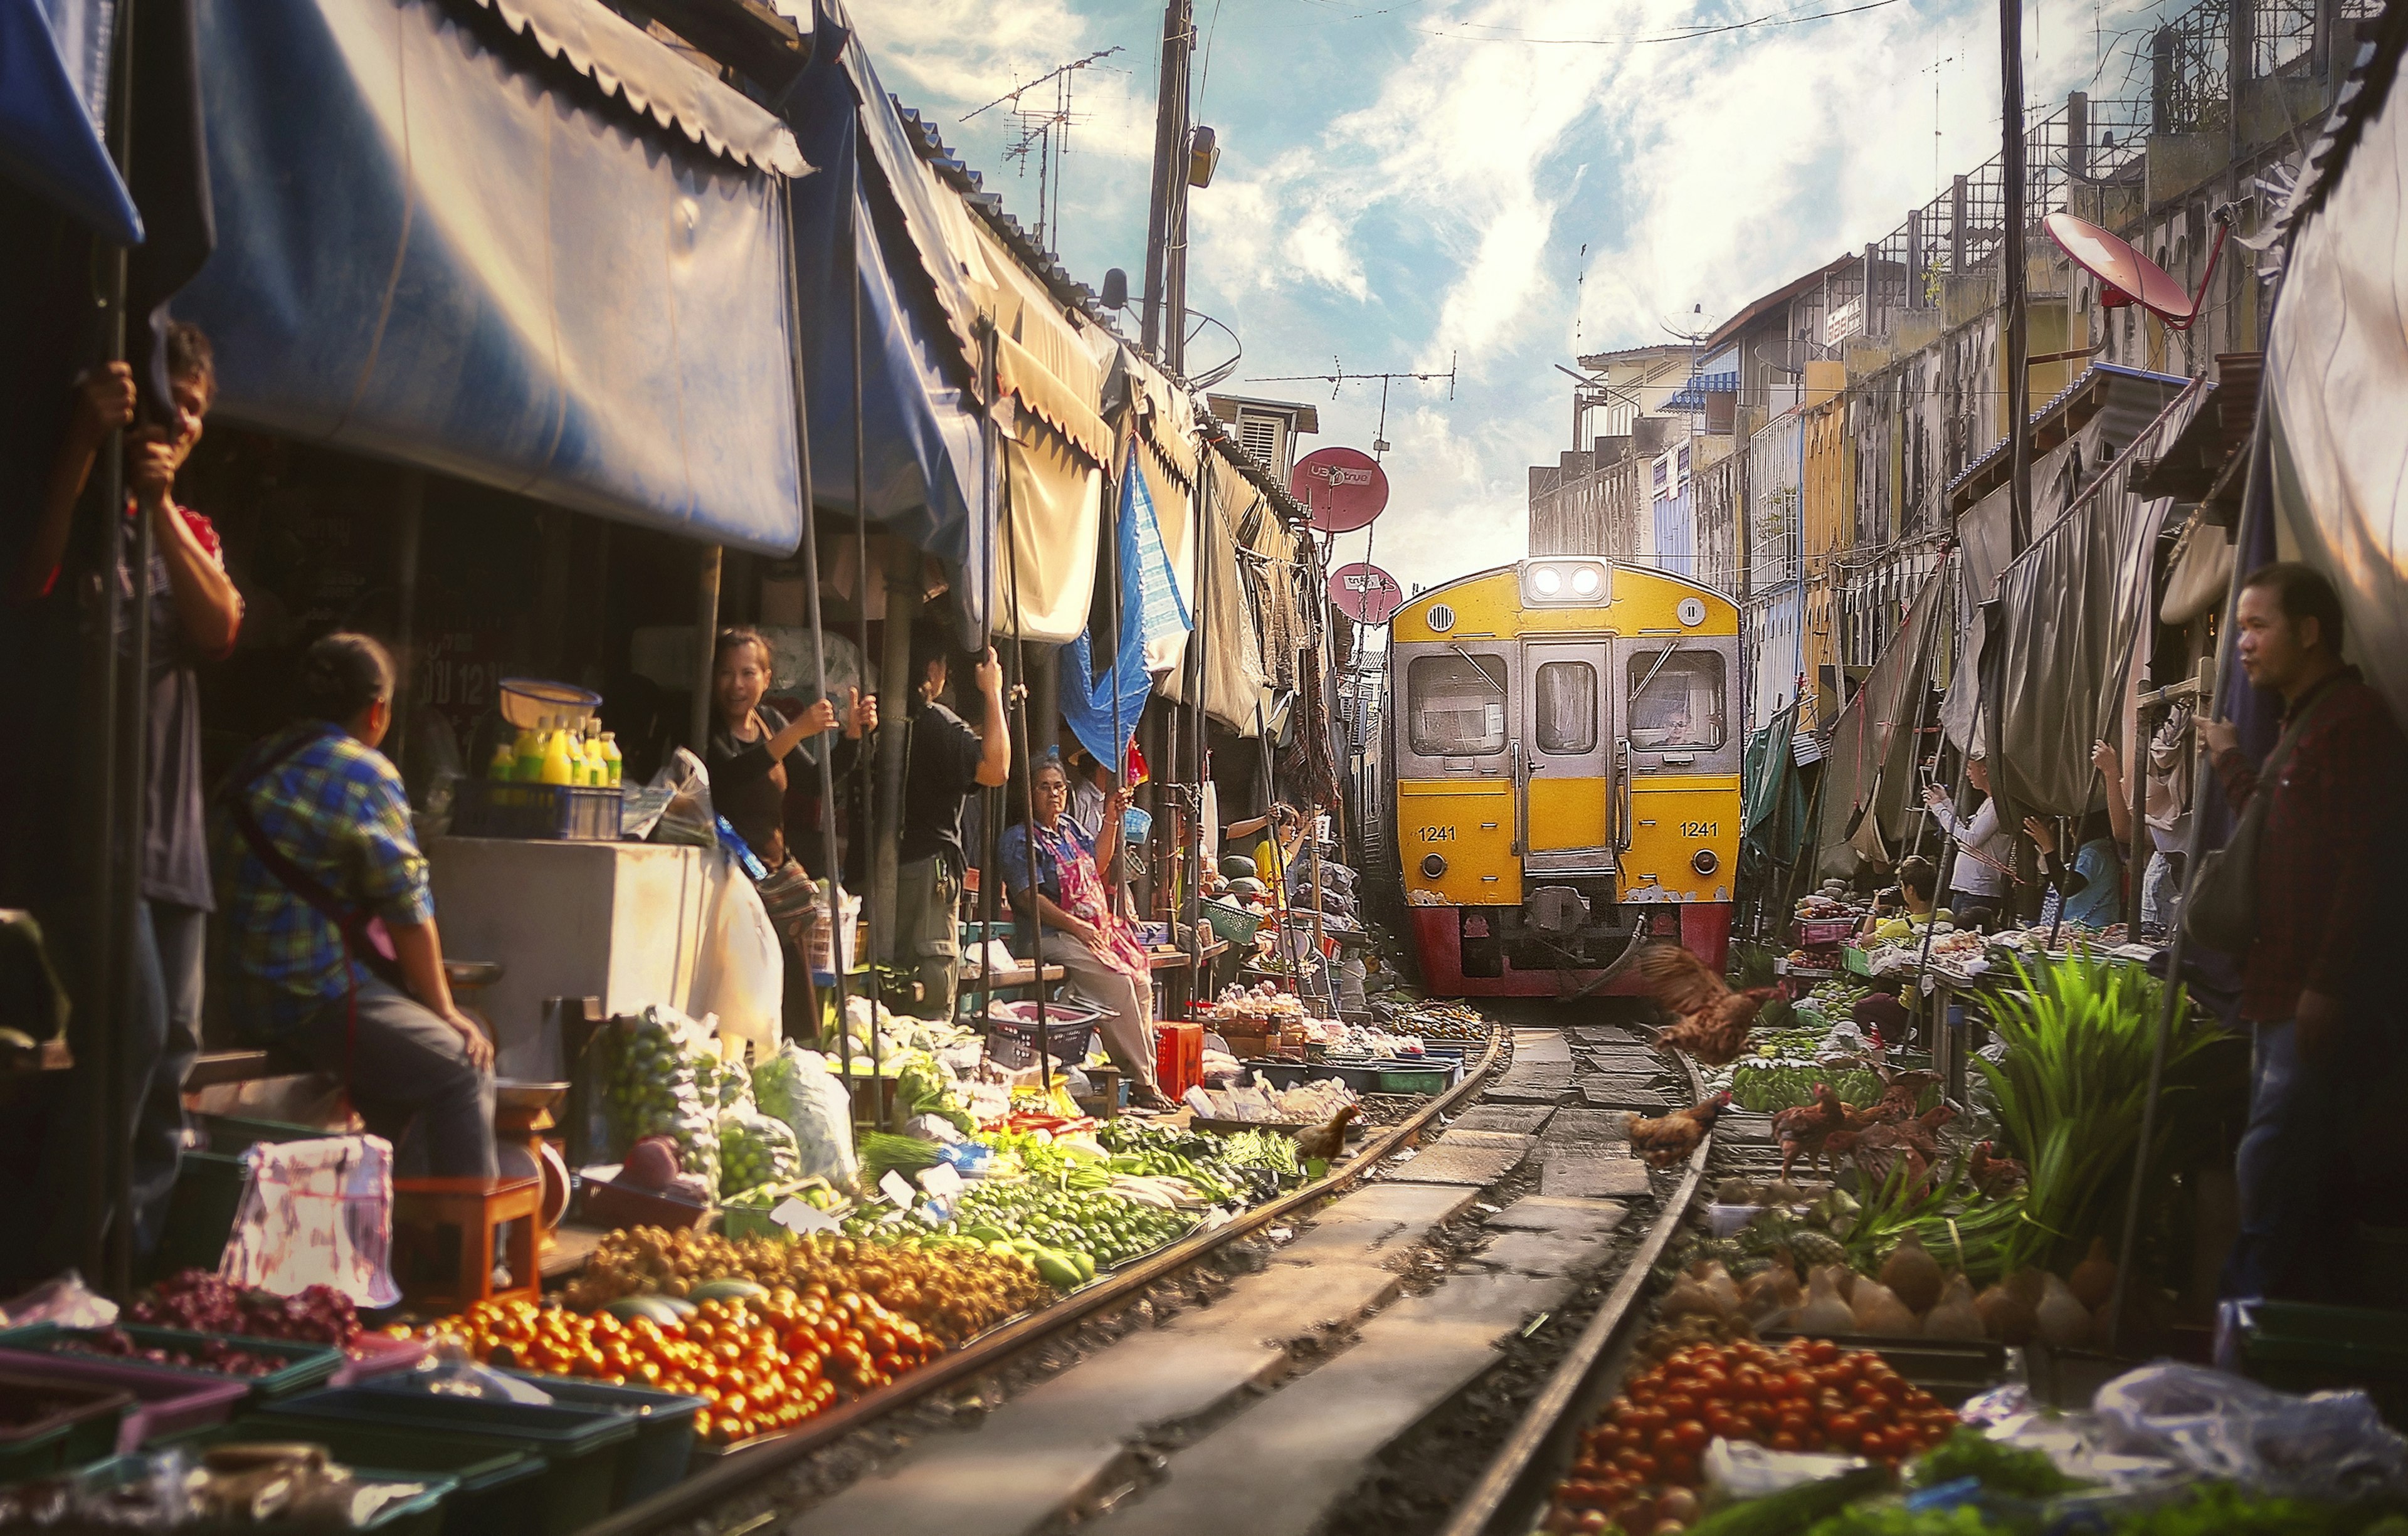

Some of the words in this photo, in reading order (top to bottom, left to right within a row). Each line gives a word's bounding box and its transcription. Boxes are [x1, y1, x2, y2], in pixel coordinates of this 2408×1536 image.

[1344, 471, 1368, 481] true
[1418, 826, 1455, 841] 1241
[1680, 822, 1717, 836] 1241
